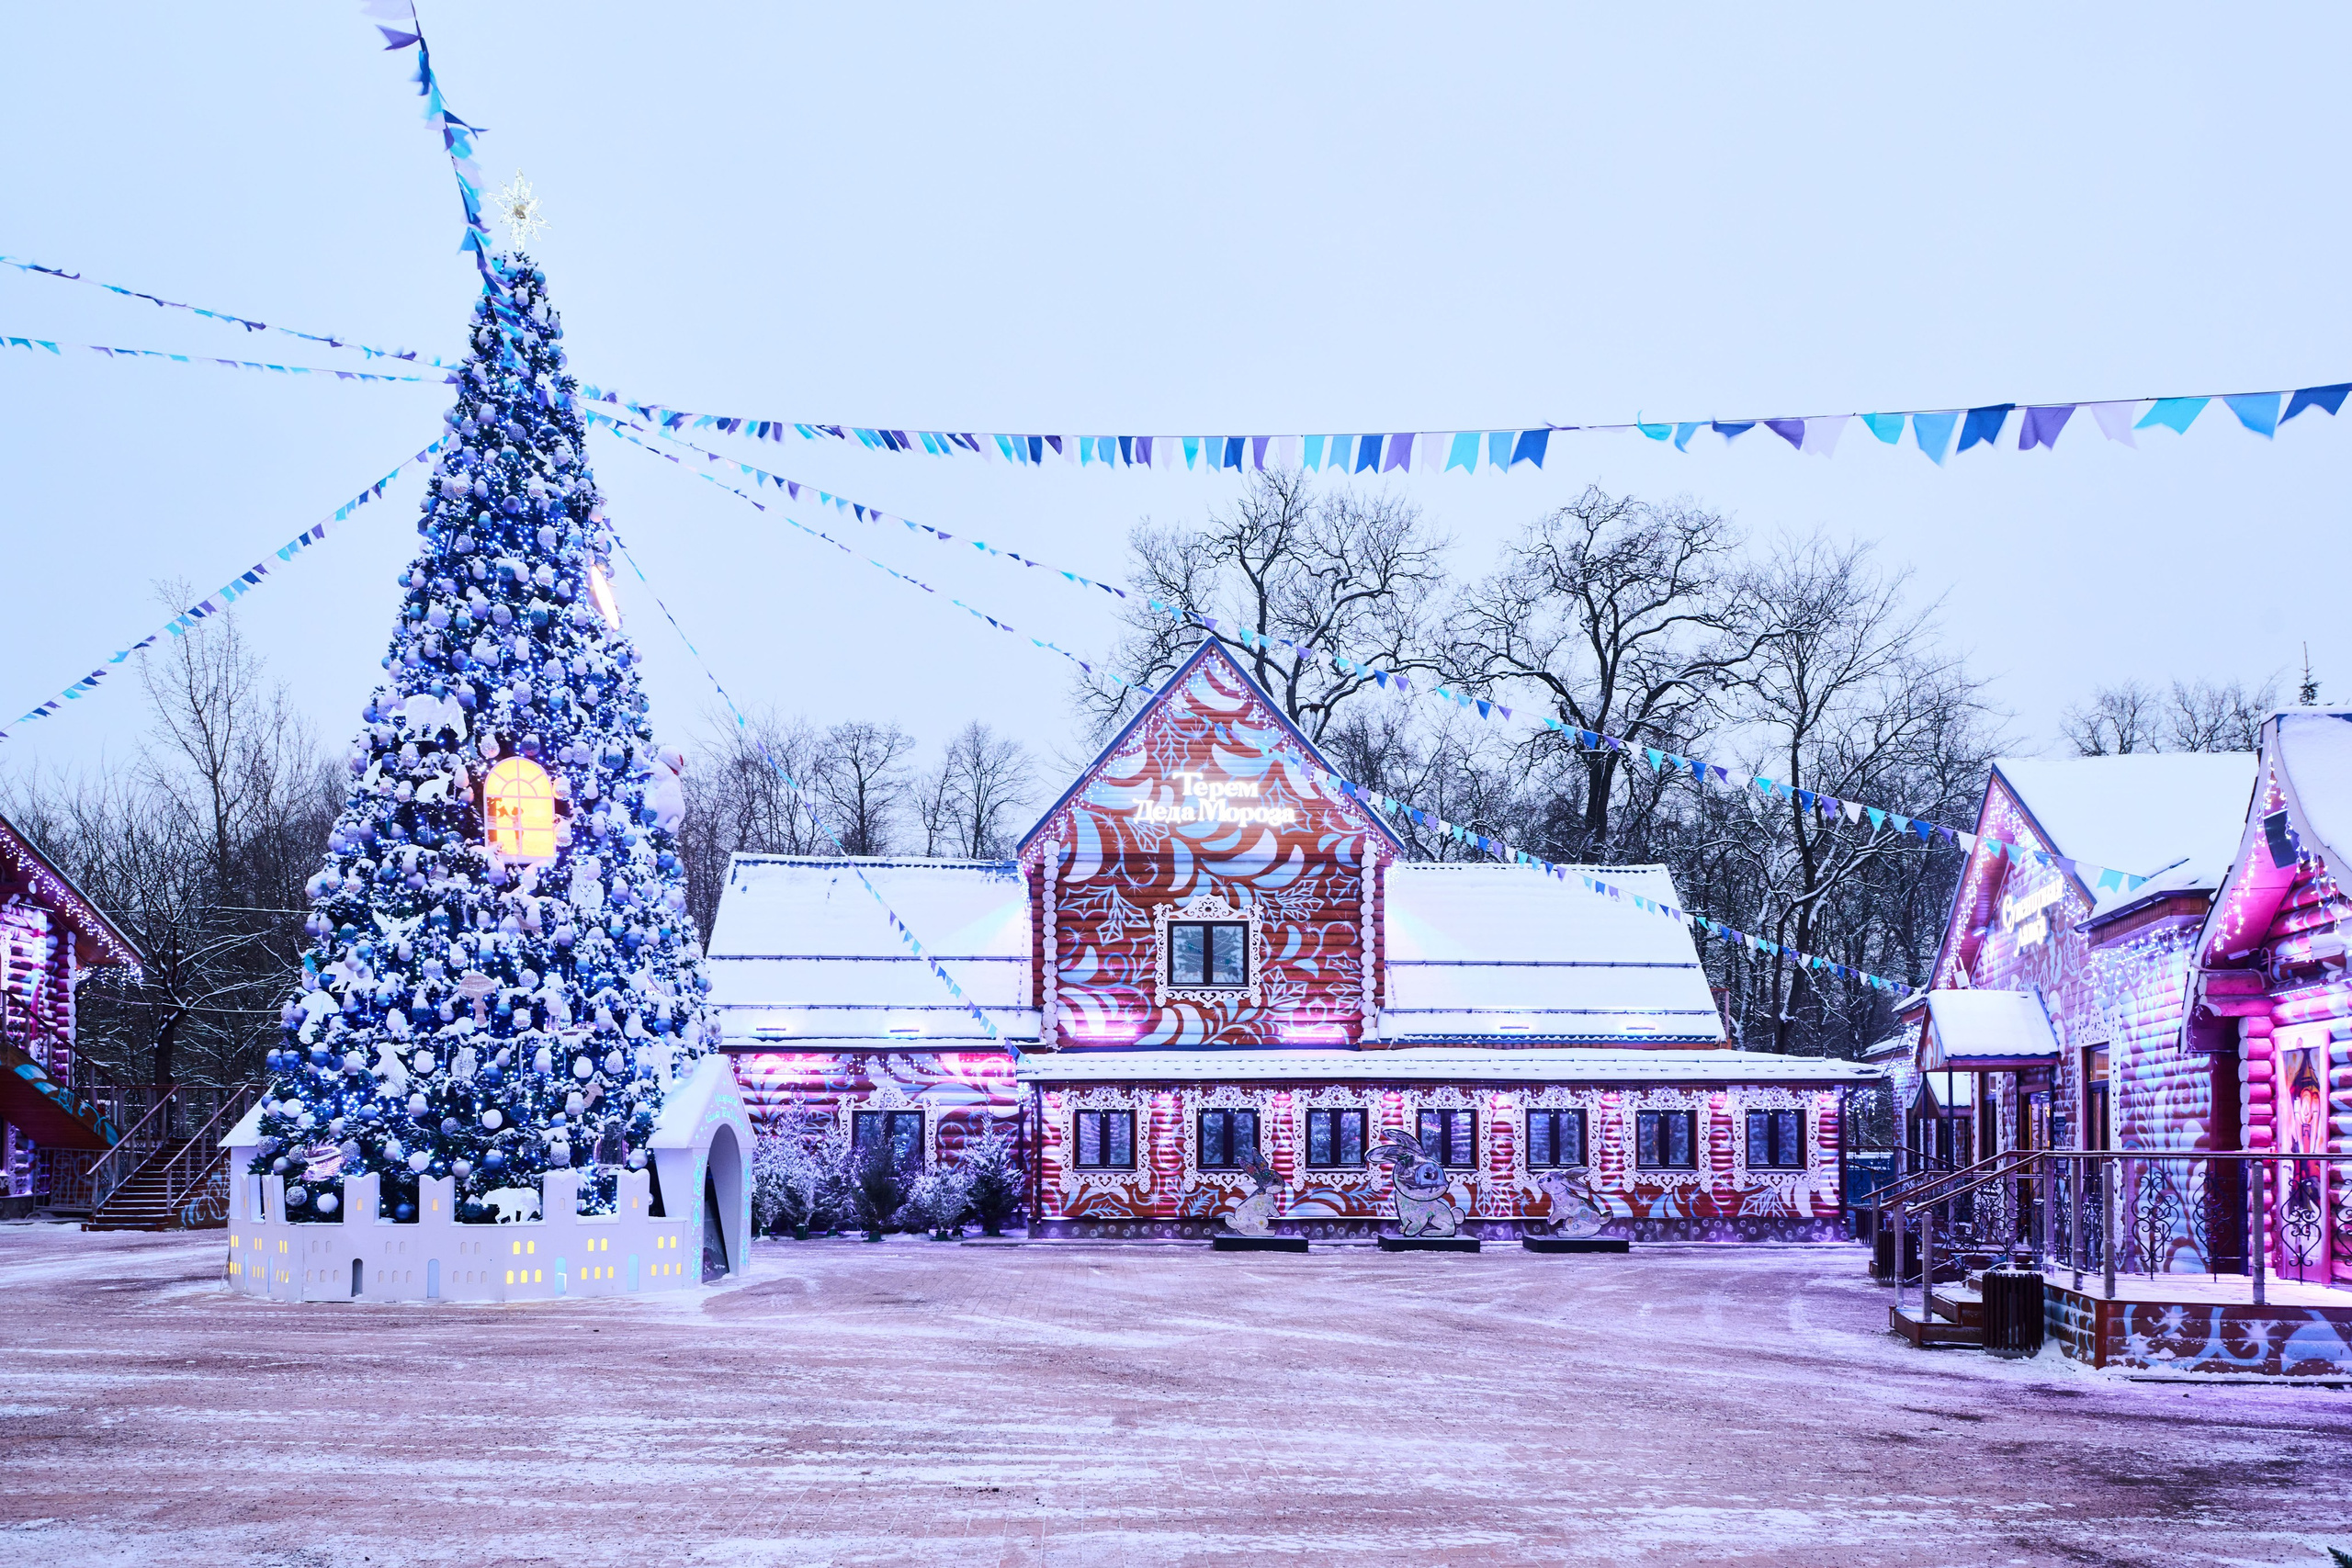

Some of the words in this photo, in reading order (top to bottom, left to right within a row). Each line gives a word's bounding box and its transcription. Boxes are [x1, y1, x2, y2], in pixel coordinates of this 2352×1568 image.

[1172, 773, 1260, 802] Терем
[1132, 798, 1195, 824] Деда
[1197, 798, 1296, 828] Мороза
